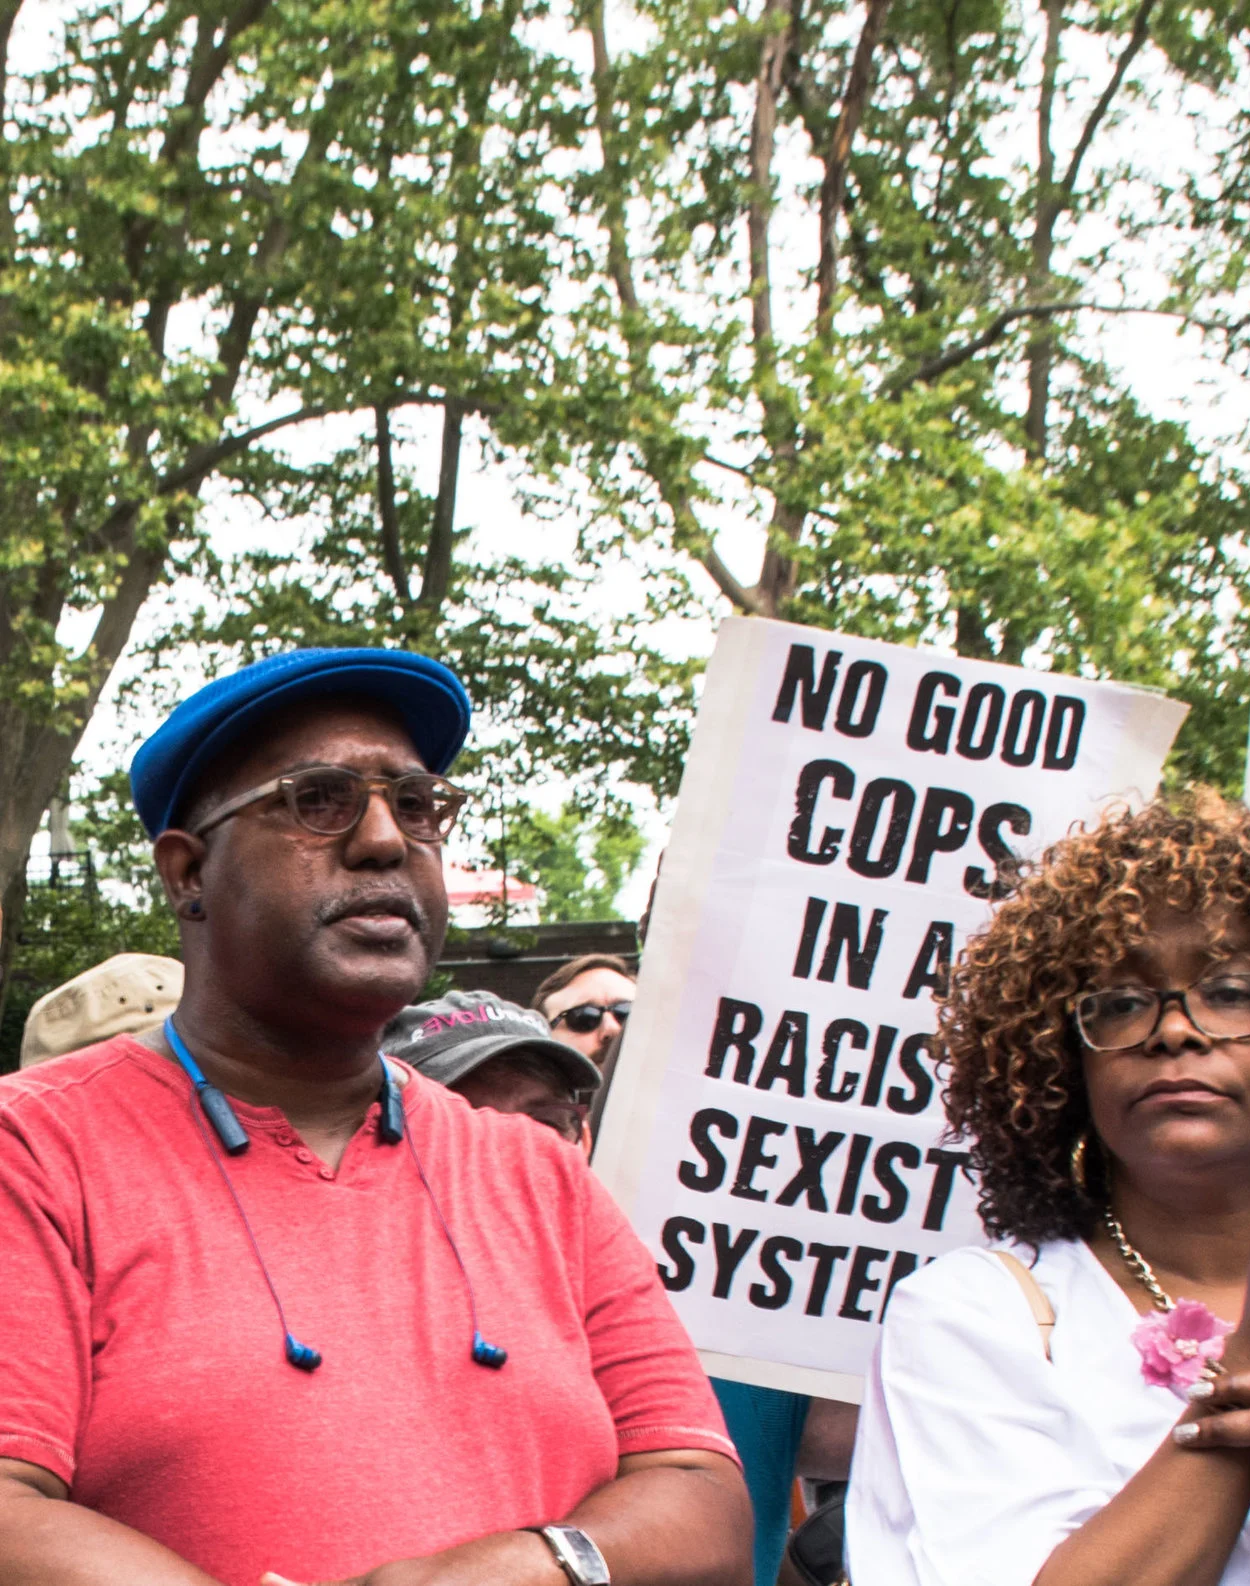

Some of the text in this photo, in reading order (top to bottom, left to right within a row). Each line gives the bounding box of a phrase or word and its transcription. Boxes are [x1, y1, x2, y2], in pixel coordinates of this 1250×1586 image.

[772, 643, 1087, 772] NO GOOD
[787, 758, 1032, 900] COPS
[792, 896, 954, 999] IN A
[703, 996, 938, 1115] RACIS
[677, 1107, 972, 1232] SEXIST
